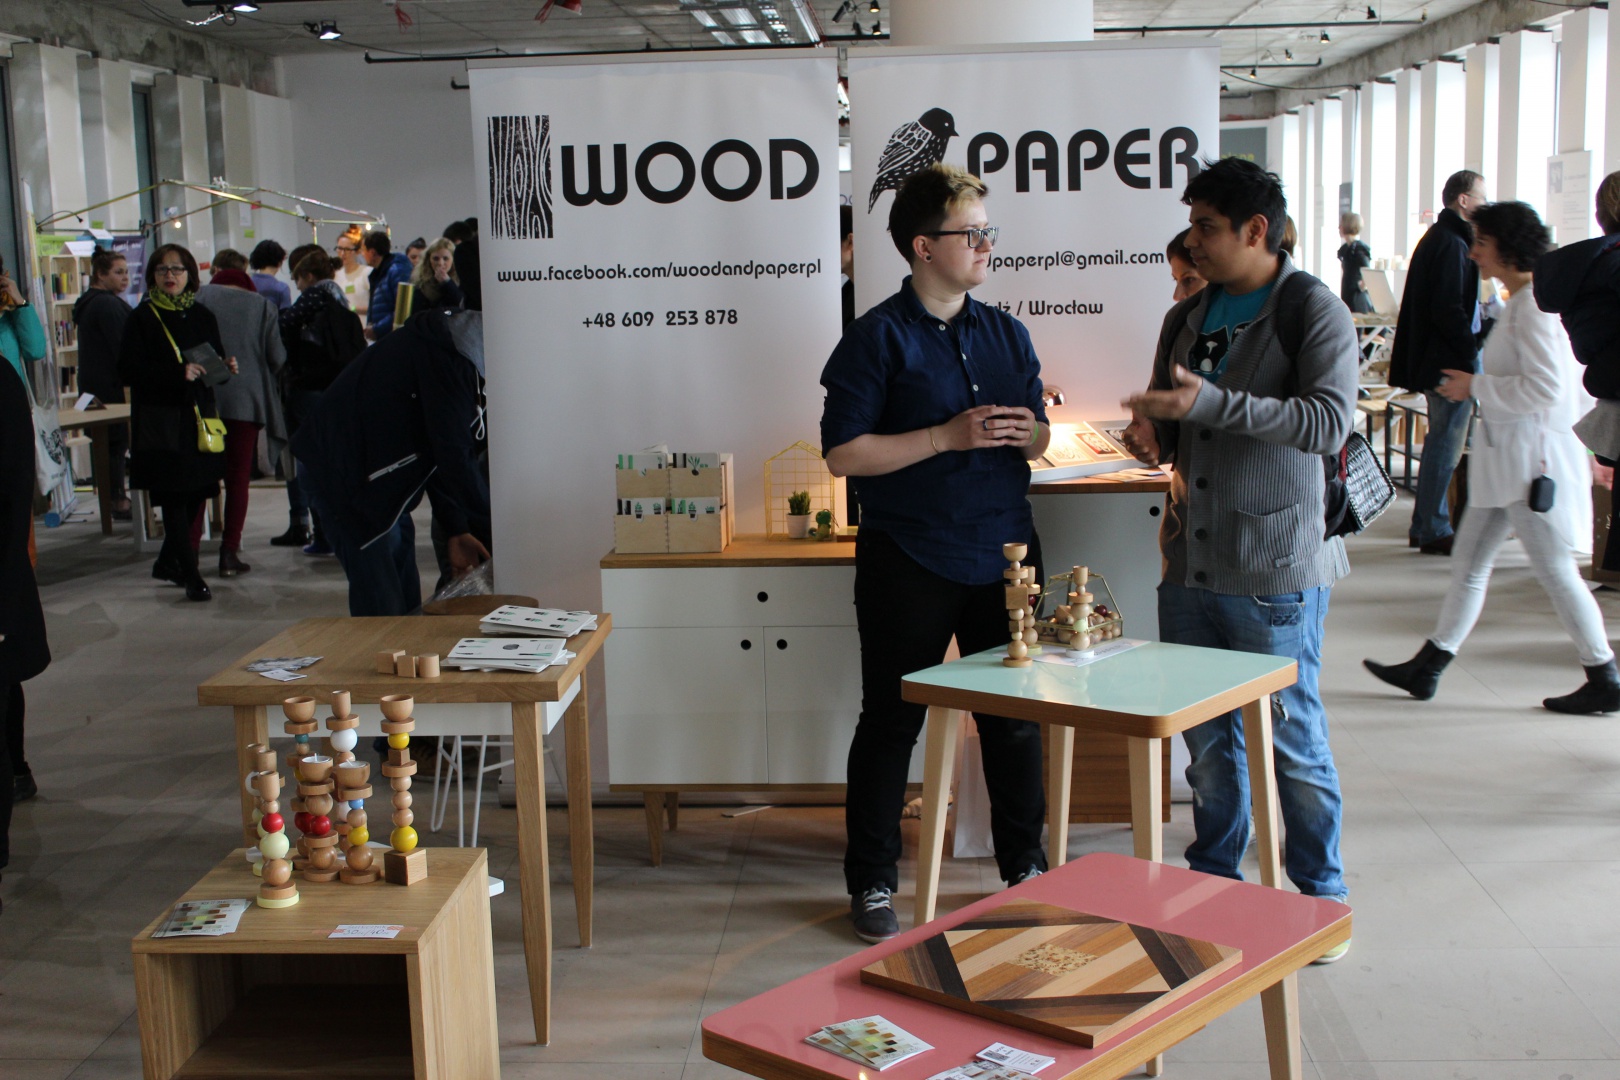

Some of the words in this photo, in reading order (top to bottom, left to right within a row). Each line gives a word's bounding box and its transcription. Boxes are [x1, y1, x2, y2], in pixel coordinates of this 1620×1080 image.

[967, 126, 1200, 193] PAPER
[560, 138, 820, 207] WOOD
[497, 258, 822, 283] www.facebook.com/woodandpaperpl
[582, 311, 616, 329] +48
[621, 310, 655, 328] 609
[665, 309, 699, 327] 253
[704, 308, 739, 326] 878
[1028, 299, 1105, 316] Wrocław
